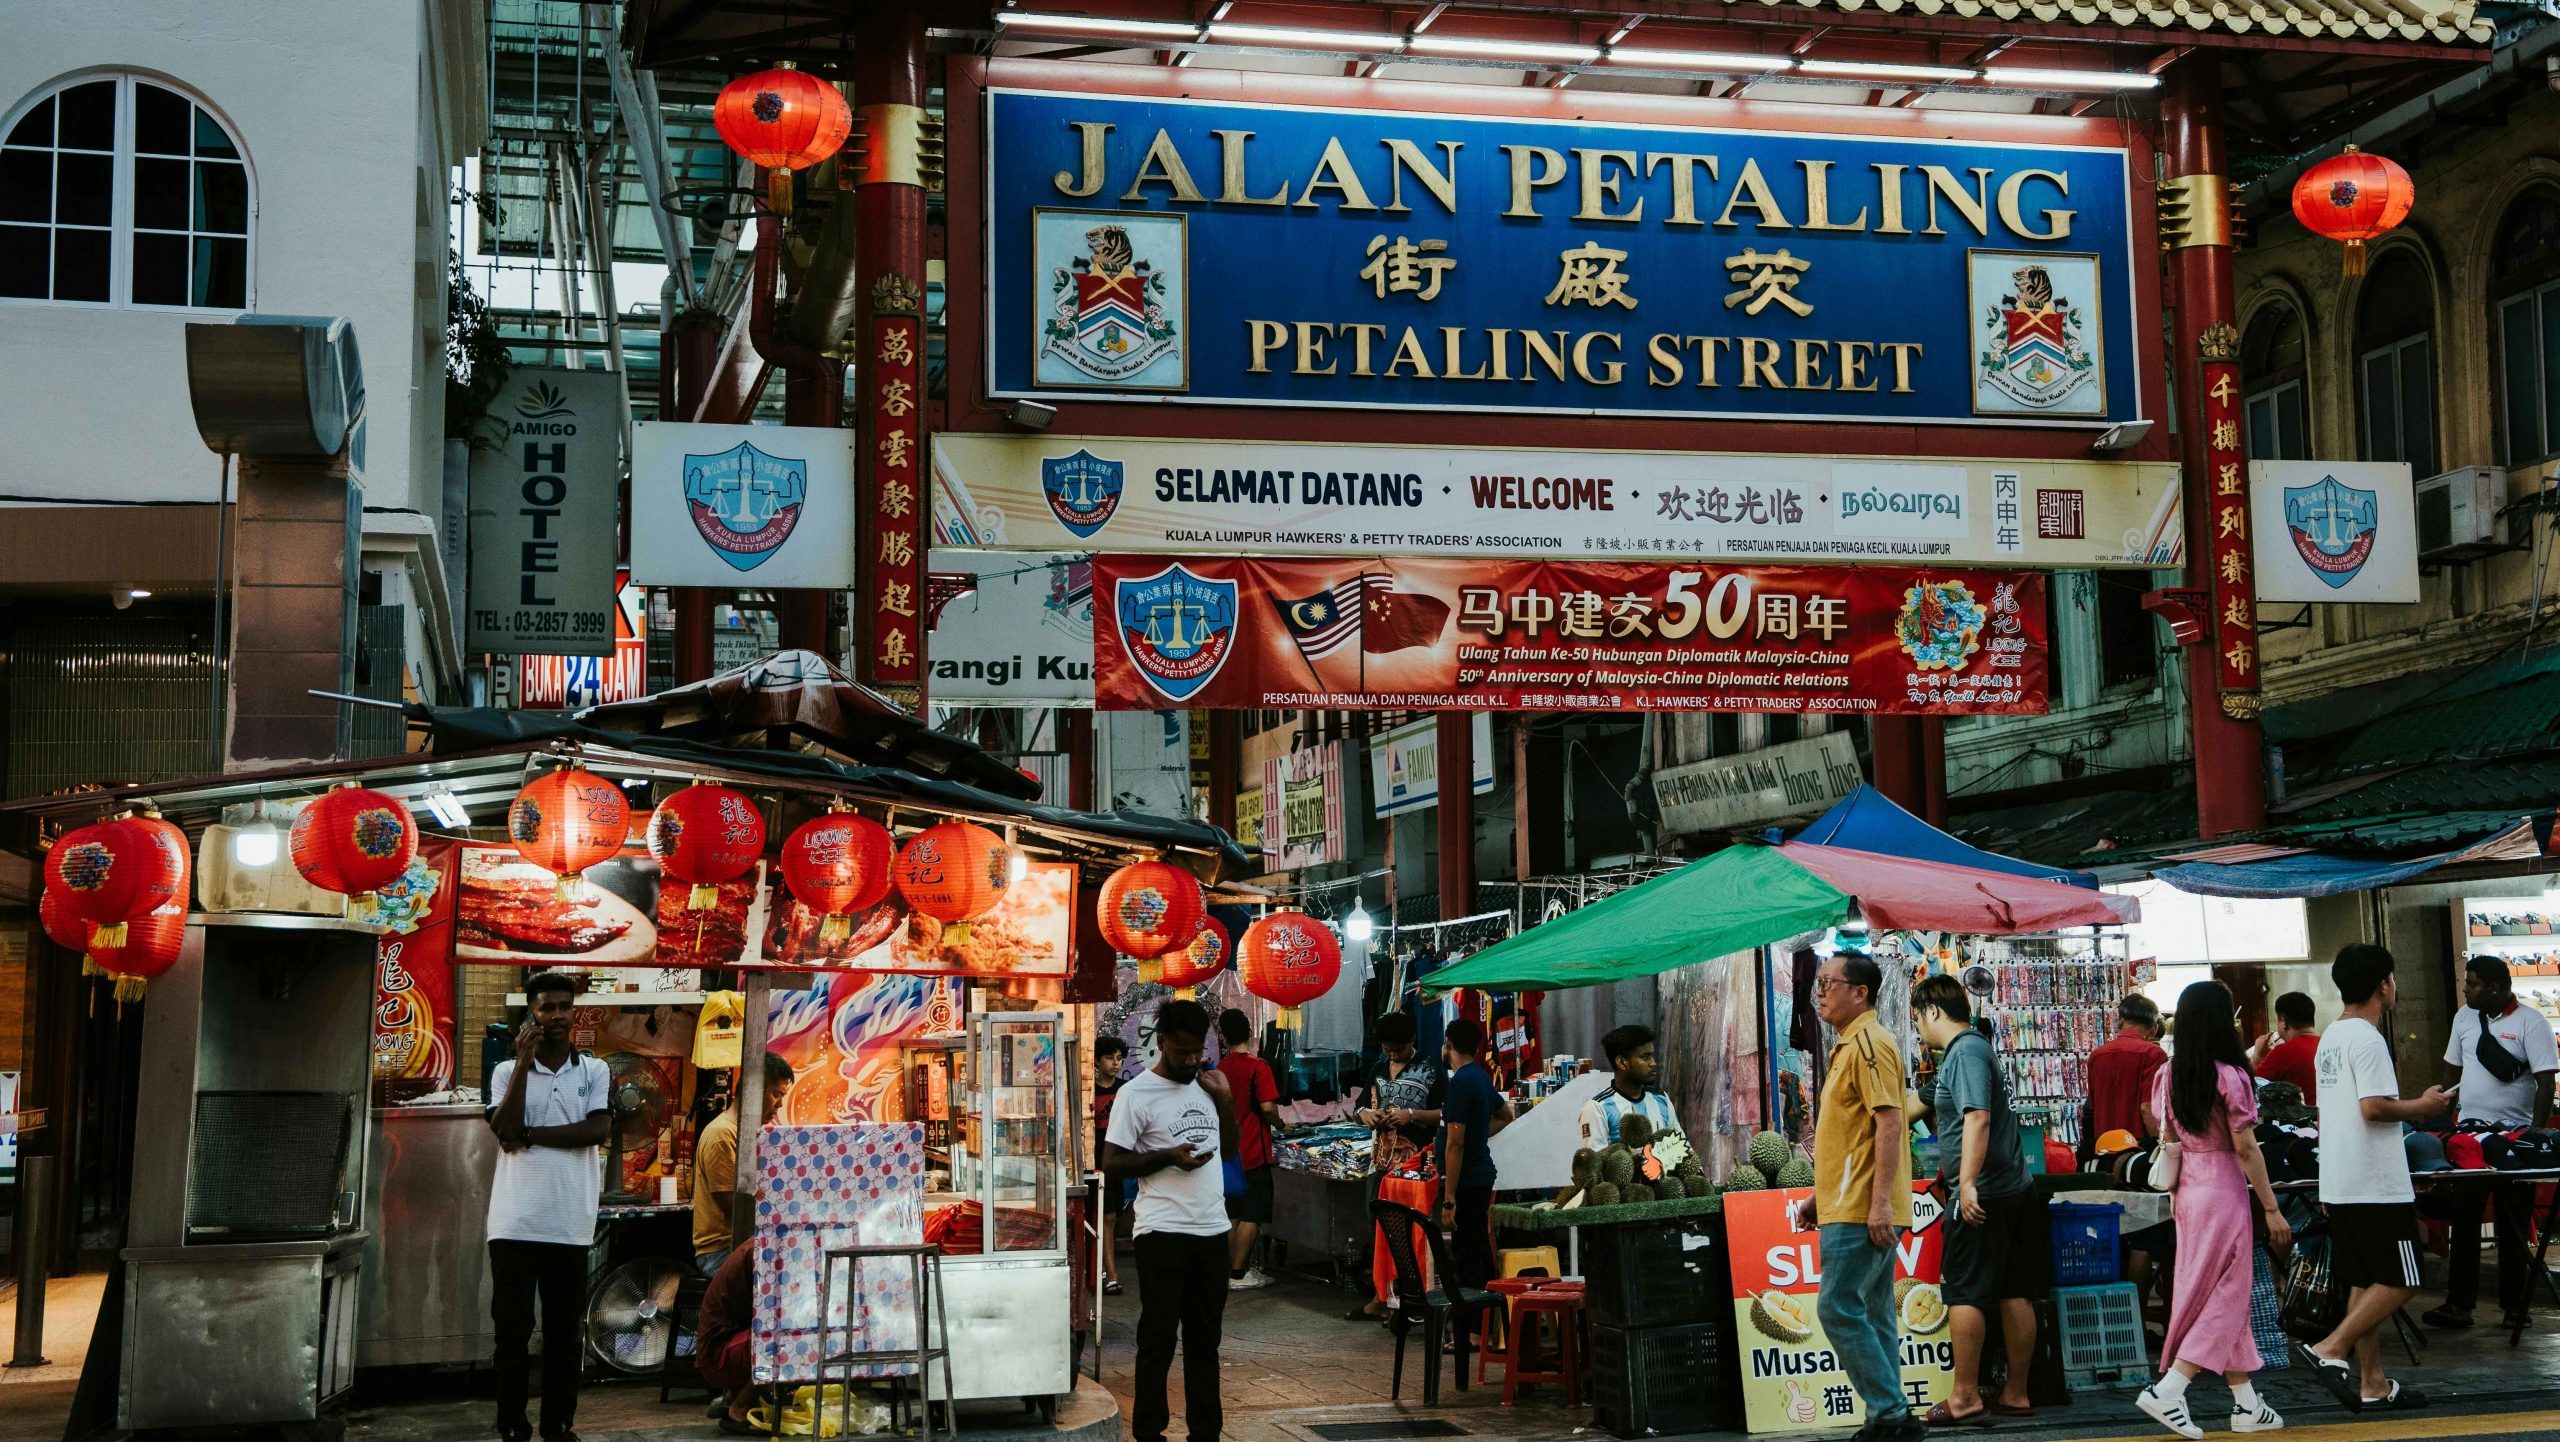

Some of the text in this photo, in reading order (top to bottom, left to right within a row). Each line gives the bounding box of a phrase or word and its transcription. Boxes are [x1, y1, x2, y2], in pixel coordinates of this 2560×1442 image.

[1054, 121, 2078, 241] JALAN PETALING
[1051, 339, 1172, 377] Dewan Bandaraya Kuala Lumpur
[1245, 319, 1924, 394] PETALING STREET
[1986, 370, 2090, 404] Dewan Bandaraya Kuala Lumpur
[512, 422, 577, 437] AMIGO
[1155, 468, 1614, 511] SELAMAT DATANG WELCOME
[1656, 484, 1804, 525] 欢迎光临
[1841, 486, 1961, 519] நல்வரவு
[1994, 474, 2020, 550] 丙申年
[519, 441, 567, 606] HOTEL
[730, 543, 754, 551] PETTY
[782, 512, 796, 533] ASSN.
[735, 523, 758, 532] 1953
[716, 525, 777, 544] KUALA LUMPUR
[1165, 530, 1212, 542] KUALA
[1216, 531, 1272, 543] LUMPUR
[1350, 534, 1359, 544] &
[1363, 534, 1404, 545] PETTY
[1475, 536, 1562, 548] ASSOCIATION
[1582, 536, 1704, 551] 吉隆坡小販商業公會
[1726, 539, 1951, 555] PERSATUAN PENJAJA DAN PENIAGA KECIL KUALA LUMPUR
[2312, 549, 2358, 563] KUALA LUMPUR
[475, 610, 502, 632] TEL
[514, 611, 568, 633] 03-2857
[573, 612, 606, 633] 3999
[1169, 650, 1190, 658] 1953
[1212, 636, 1226, 658] ASSN.
[1985, 638, 2027, 653] LOONG
[1150, 651, 1210, 669] KUALA LUMPUR
[1459, 646, 1849, 667] Ulang Tahun Ke-50 Hubungan Diplomatik Malaysia-China
[1990, 653, 2022, 667] KEE
[525, 654, 562, 703] BUKA
[565, 655, 600, 707] 24
[603, 648, 640, 703] JAM
[1038, 655, 1095, 681] Ku
[1459, 668, 1849, 688] 50th Anniversary of Malaysia-China Diplomatic Relations
[1263, 693, 1509, 706] PERSATUAN PENJAJA DAN PENIAGA KECIL K.L.
[1520, 694, 1621, 708] 吉隆坡小販商業公會
[1636, 696, 1655, 708] K.L.
[1714, 697, 1722, 708] &
[1723, 697, 1754, 708] PETTY
[1808, 697, 1877, 710] ASSOCIATION
[1907, 688, 1928, 705] Try
[1976, 690, 2001, 703] Love
[1160, 763, 1186, 773] Malaysia
[1407, 743, 1436, 784] FAMILY
[1775, 755, 1824, 806] HOONG
[1820, 747, 1860, 798] HING
[586, 806, 619, 825] KEE
[718, 796, 758, 845] 龍記
[803, 828, 853, 848] LOONG
[809, 847, 848, 865] KEE
[906, 838, 944, 885] 龍記
[1277, 925, 1320, 969] 龍記
[1168, 1115, 1218, 1136] BROOKLYN
